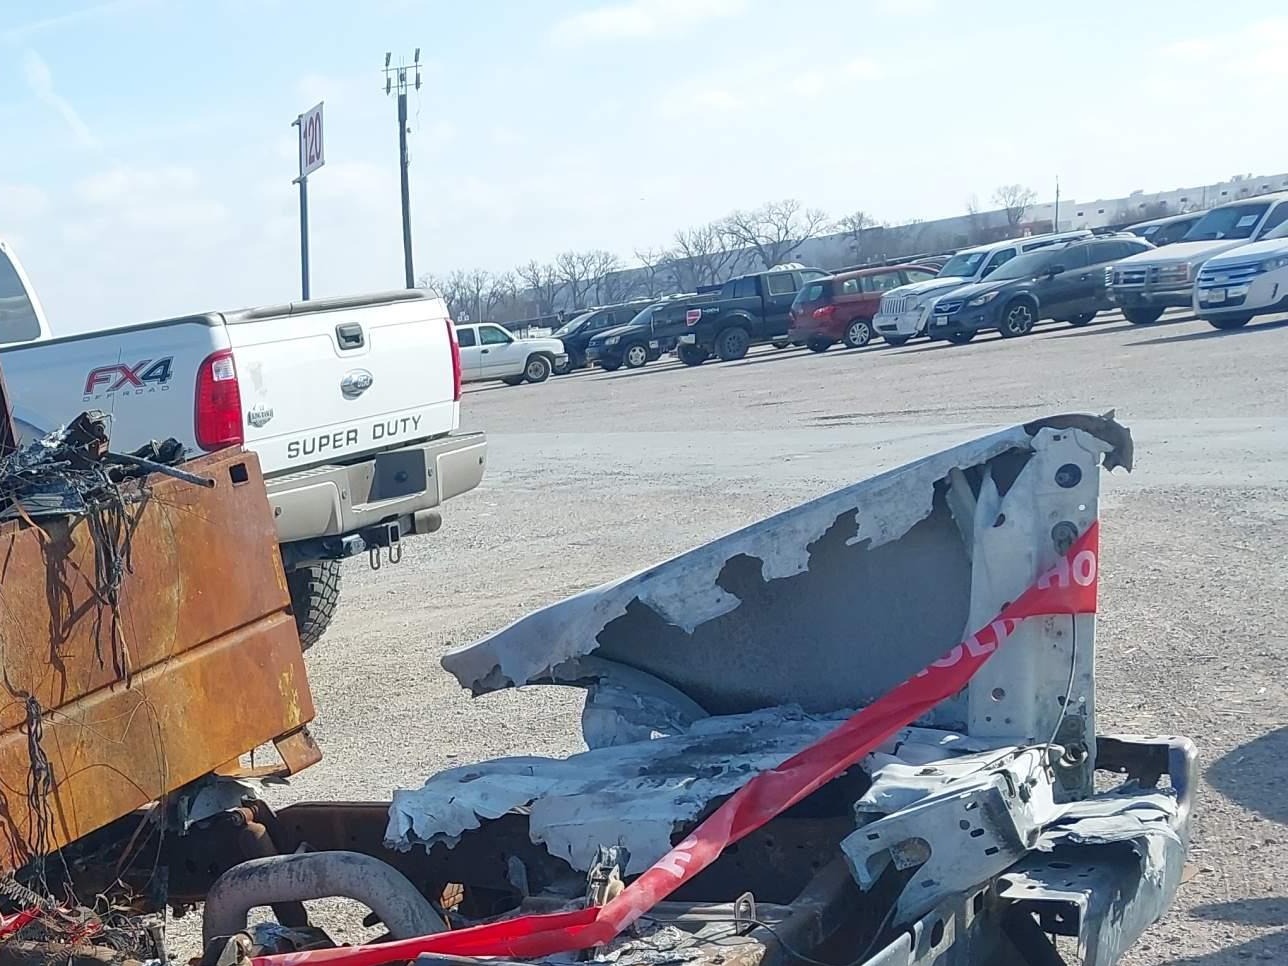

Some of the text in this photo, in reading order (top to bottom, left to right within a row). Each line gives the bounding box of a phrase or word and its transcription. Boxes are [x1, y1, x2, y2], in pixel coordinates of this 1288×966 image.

[303, 111, 322, 168] 120
[84, 356, 174, 395] FX4
[122, 385, 170, 397] ROAD
[287, 414, 422, 459] SUPER DUTY
